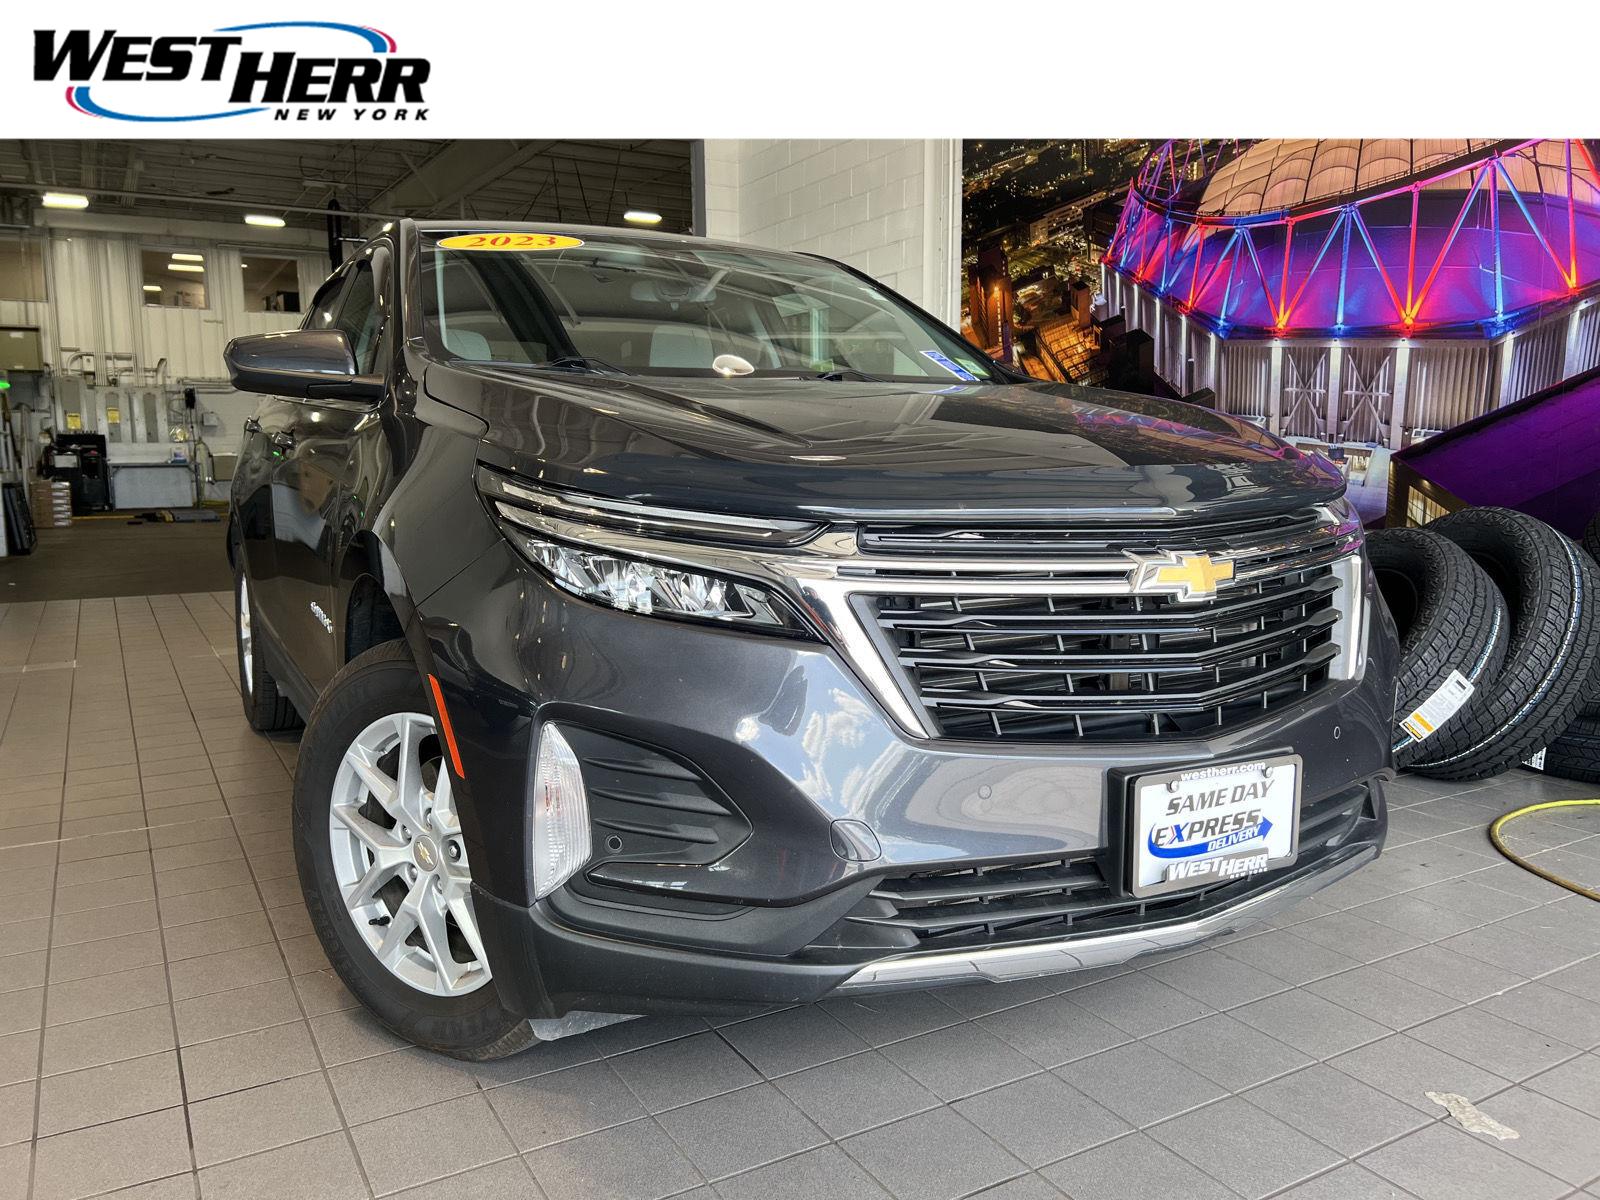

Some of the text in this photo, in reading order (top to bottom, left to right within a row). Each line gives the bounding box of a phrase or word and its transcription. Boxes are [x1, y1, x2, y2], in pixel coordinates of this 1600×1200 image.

[466, 236, 556, 247] 2023
[1181, 762, 1266, 781] westherr.com
[1166, 779, 1275, 816] SAME DAY
[1154, 809, 1261, 847] EXPRESS
[1207, 824, 1261, 852] DELIVERY
[1169, 853, 1268, 881] WEST HERR
